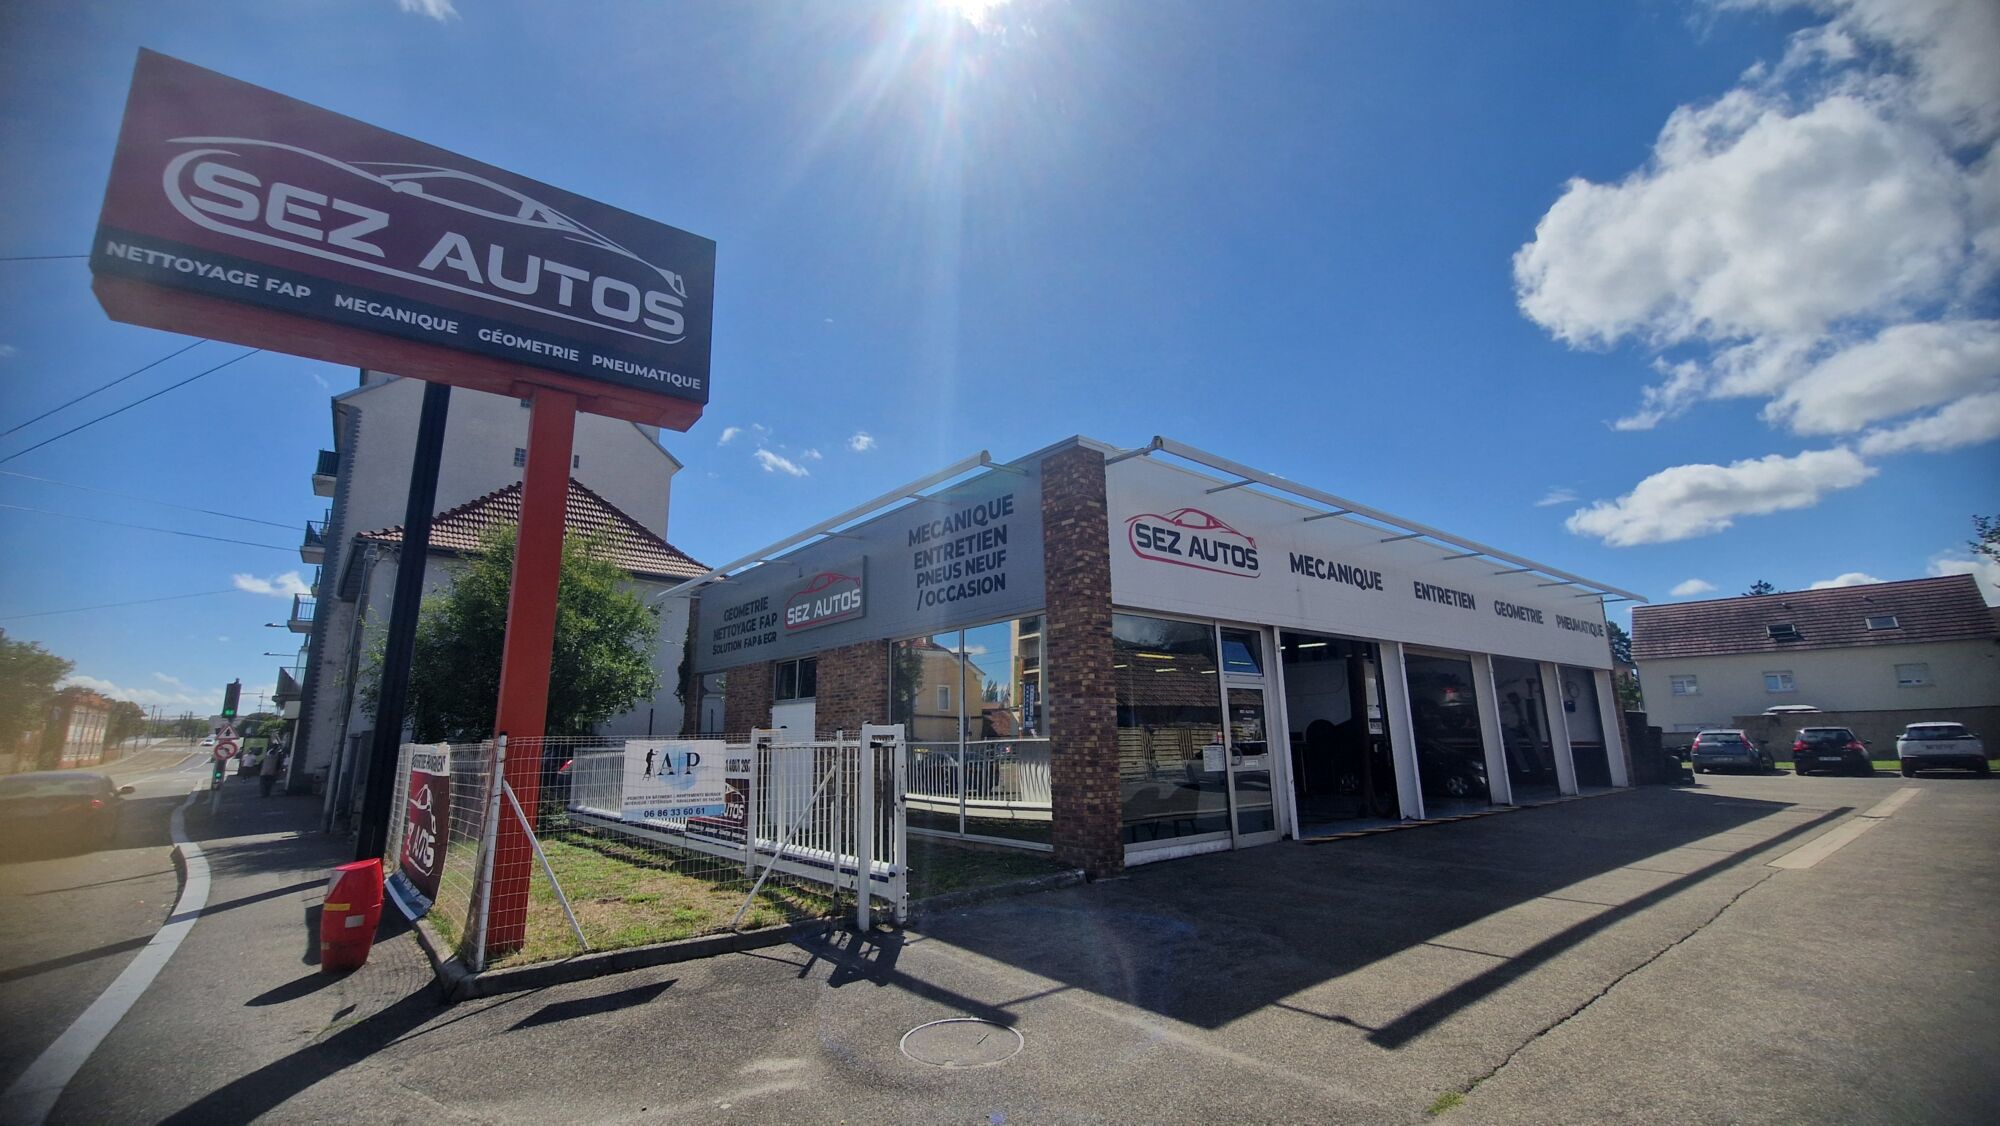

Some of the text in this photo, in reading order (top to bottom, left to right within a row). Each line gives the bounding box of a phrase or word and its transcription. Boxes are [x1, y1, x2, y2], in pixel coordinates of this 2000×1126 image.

[189, 162, 685, 335] SEZ AUTOS
[106, 240, 702, 391] NETTOYAGE FAP MECANIQUE GÉOMETRIE PNEUMATIQUE
[908, 493, 1014, 547] MECANIQUE
[914, 524, 1008, 570] ENTRETIEN
[1135, 522, 1259, 571] SEZ AUTOS
[916, 549, 1007, 589] PNEUS NEUF
[723, 596, 769, 623] GEOMETRIE
[787, 588, 861, 625] SEZ AUTOS
[1289, 551, 1605, 638] MECANIQUE ENTRETIEN GEOMETRIE PNEUMATIQUE
[713, 612, 778, 642] NETTOYAGE FAP
[712, 639, 743, 656] SOLUTION
[644, 807, 705, 818] 06 86 33 60 61
[724, 803, 745, 820] UTOS
